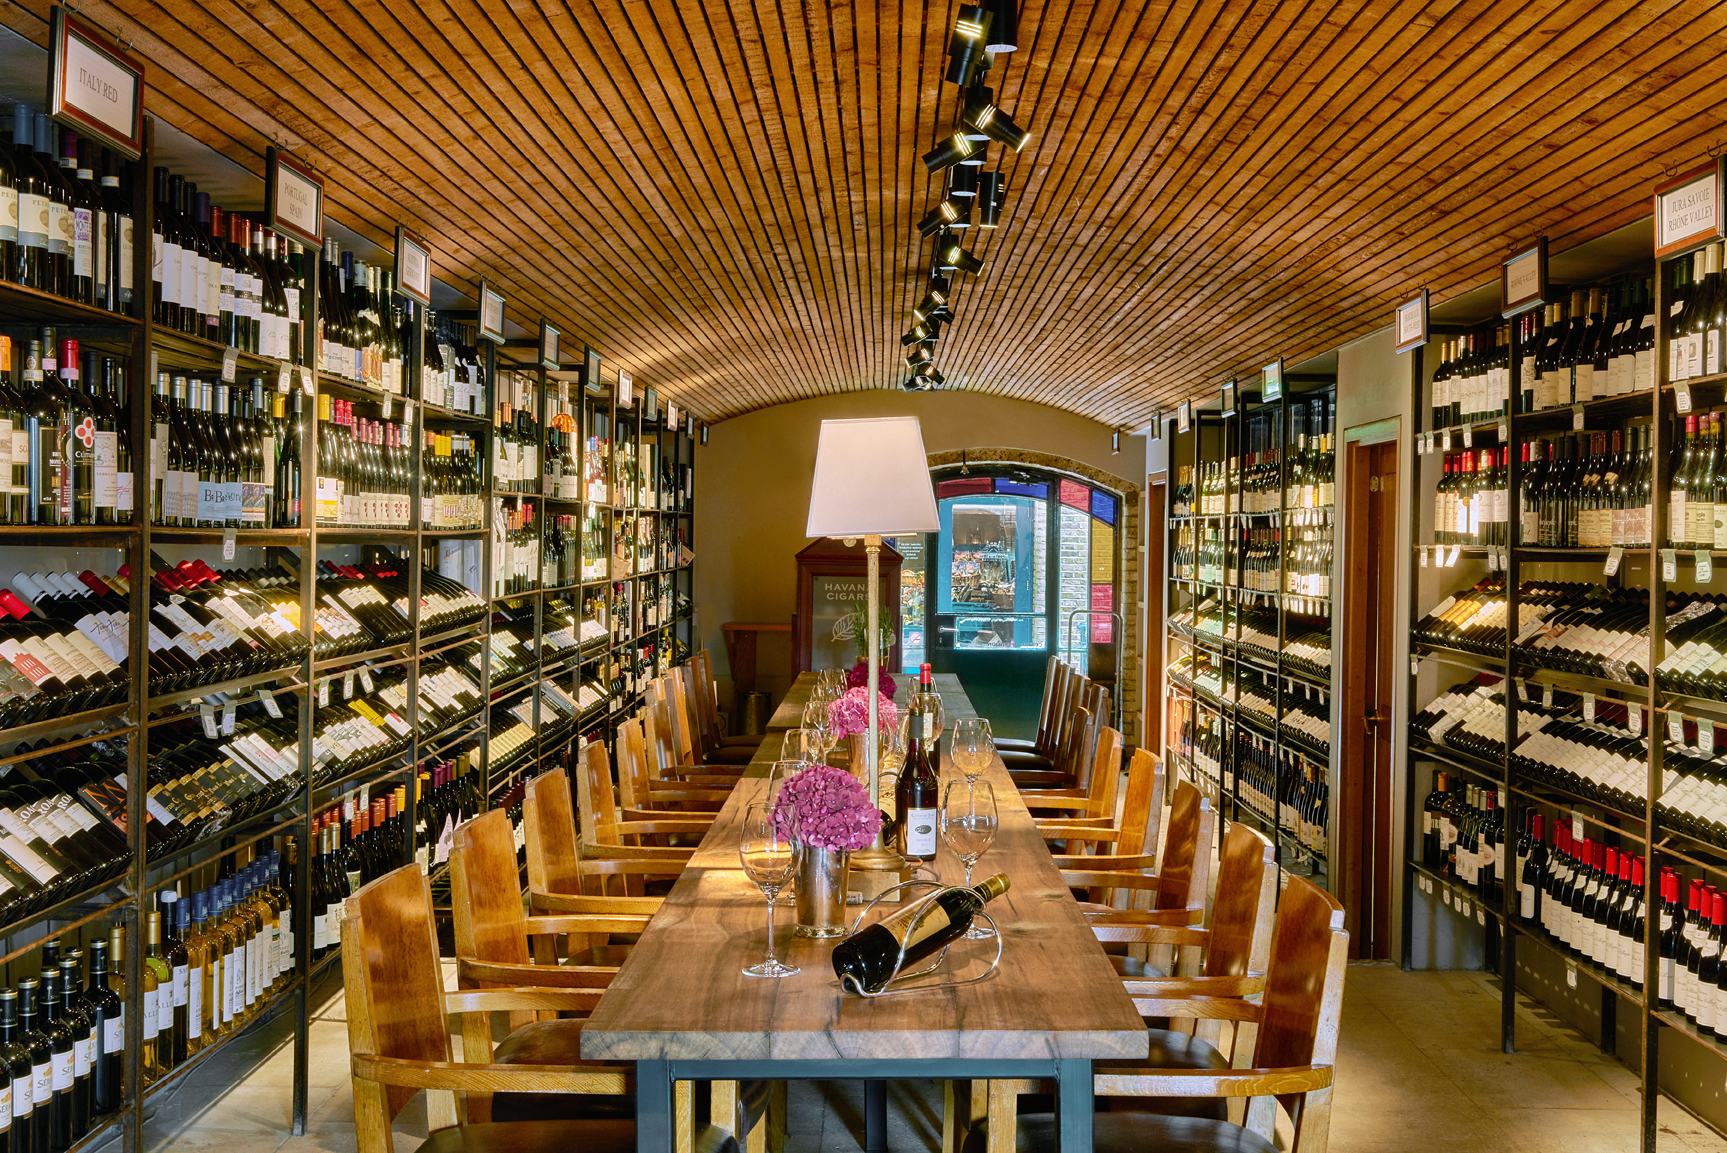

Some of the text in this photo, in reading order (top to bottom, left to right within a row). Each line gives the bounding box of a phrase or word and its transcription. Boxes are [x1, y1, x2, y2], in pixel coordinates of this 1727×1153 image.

[79, 67, 118, 103] ITALY RED
[284, 182, 308, 220] PORTUGAL SPAIN
[1672, 187, 1710, 213] JURA SAVOIE
[1669, 204, 1714, 232] RHÔNE VALLEY
